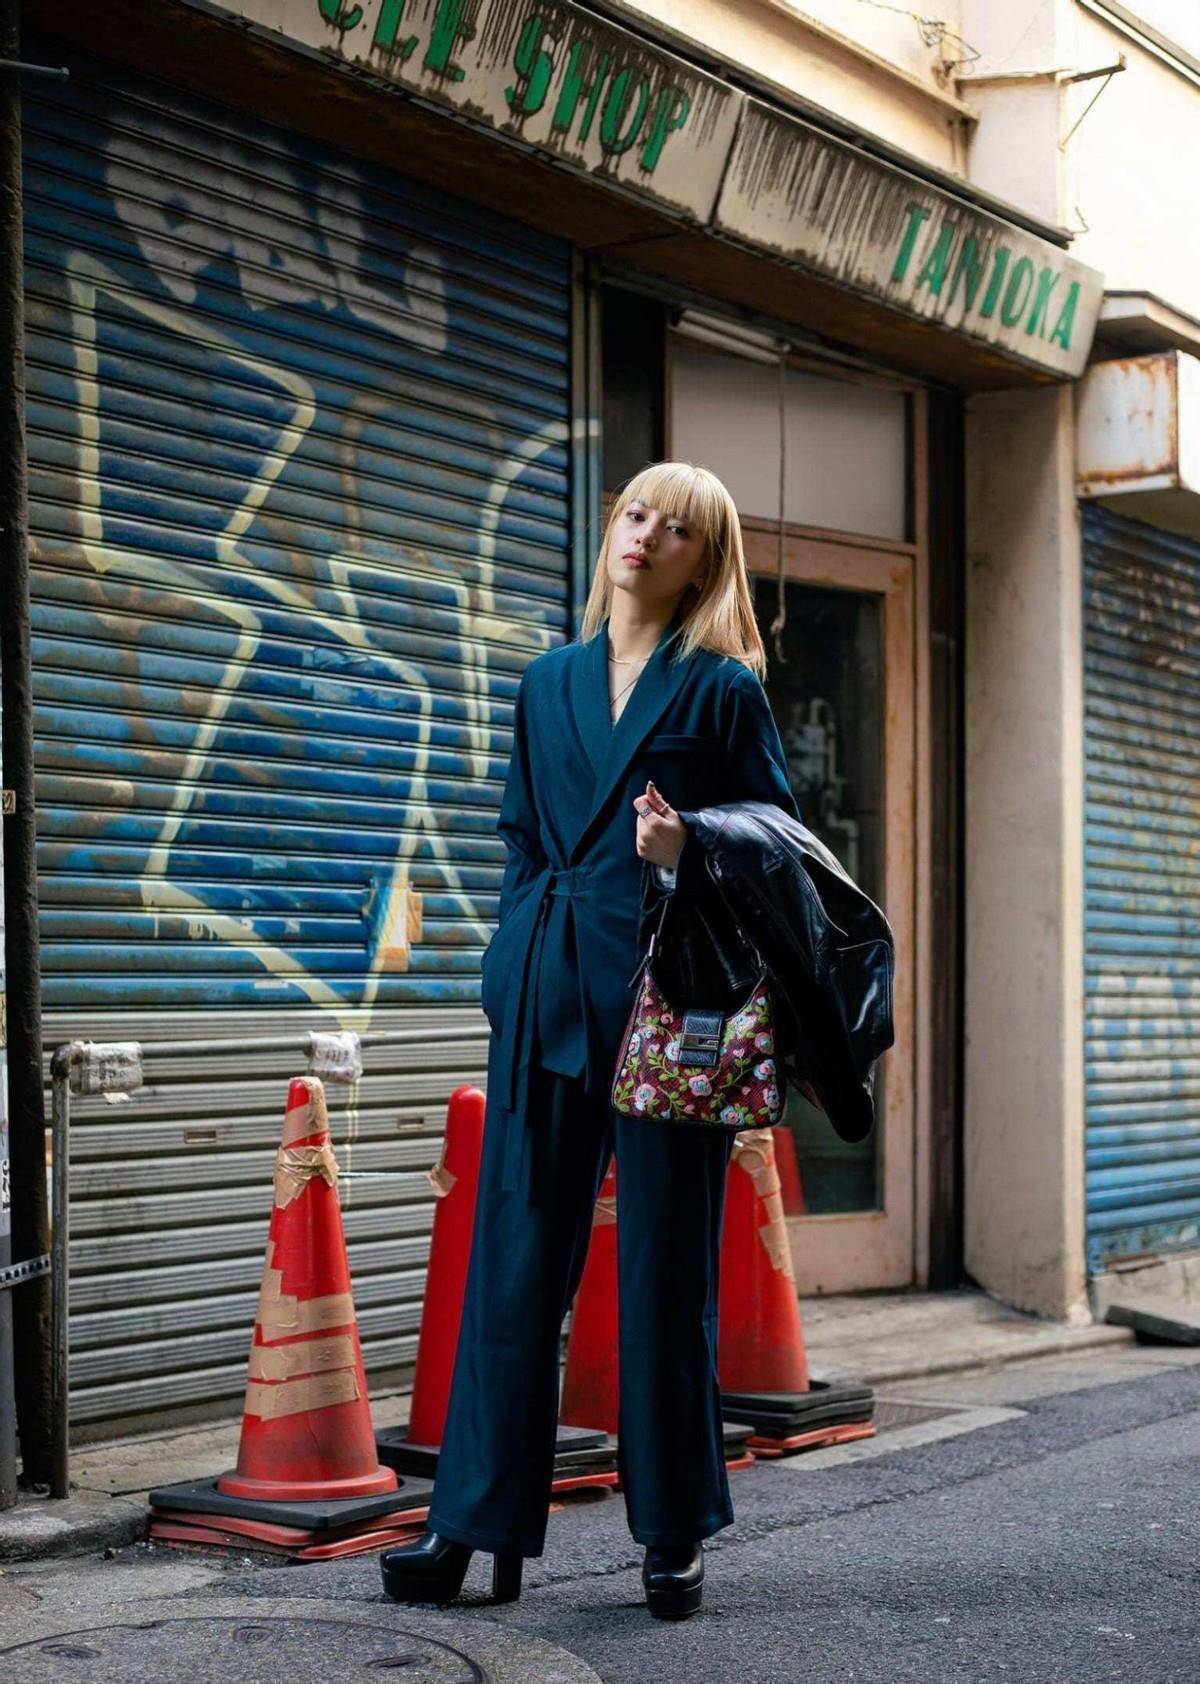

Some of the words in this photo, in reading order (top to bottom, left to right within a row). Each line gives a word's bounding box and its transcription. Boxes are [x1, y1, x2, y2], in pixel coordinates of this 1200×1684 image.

[318, 0, 476, 82] LE
[504, 15, 690, 172] SHOP
[891, 205, 1081, 350] TANIOKA
